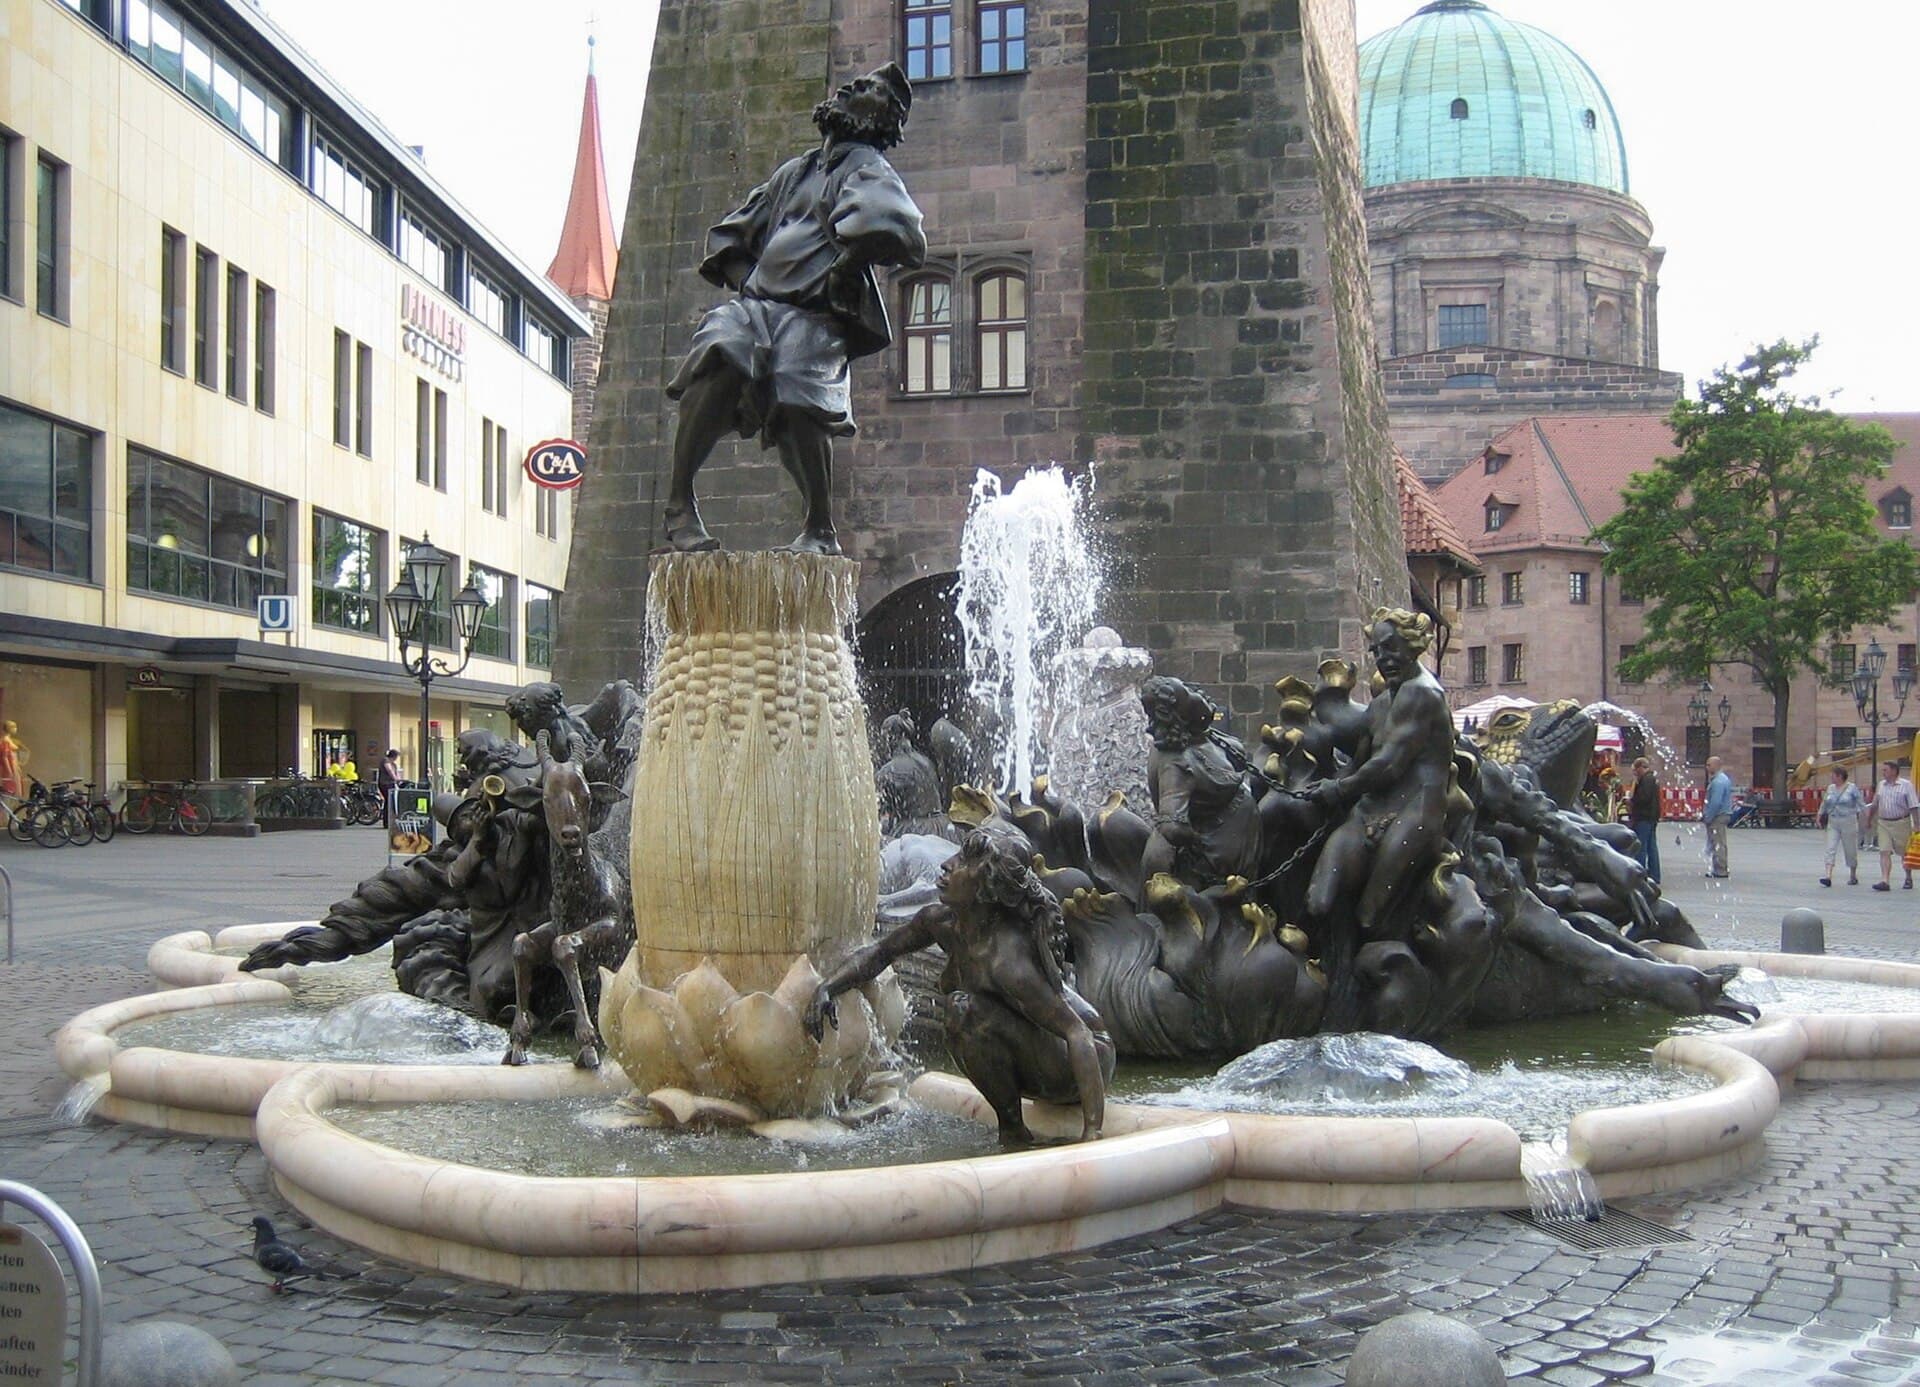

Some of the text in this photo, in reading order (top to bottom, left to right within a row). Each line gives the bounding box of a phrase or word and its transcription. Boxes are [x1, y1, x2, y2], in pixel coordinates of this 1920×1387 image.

[537, 451, 580, 475] C&A
[263, 599, 286, 628] U
[139, 671, 156, 682] C&A
